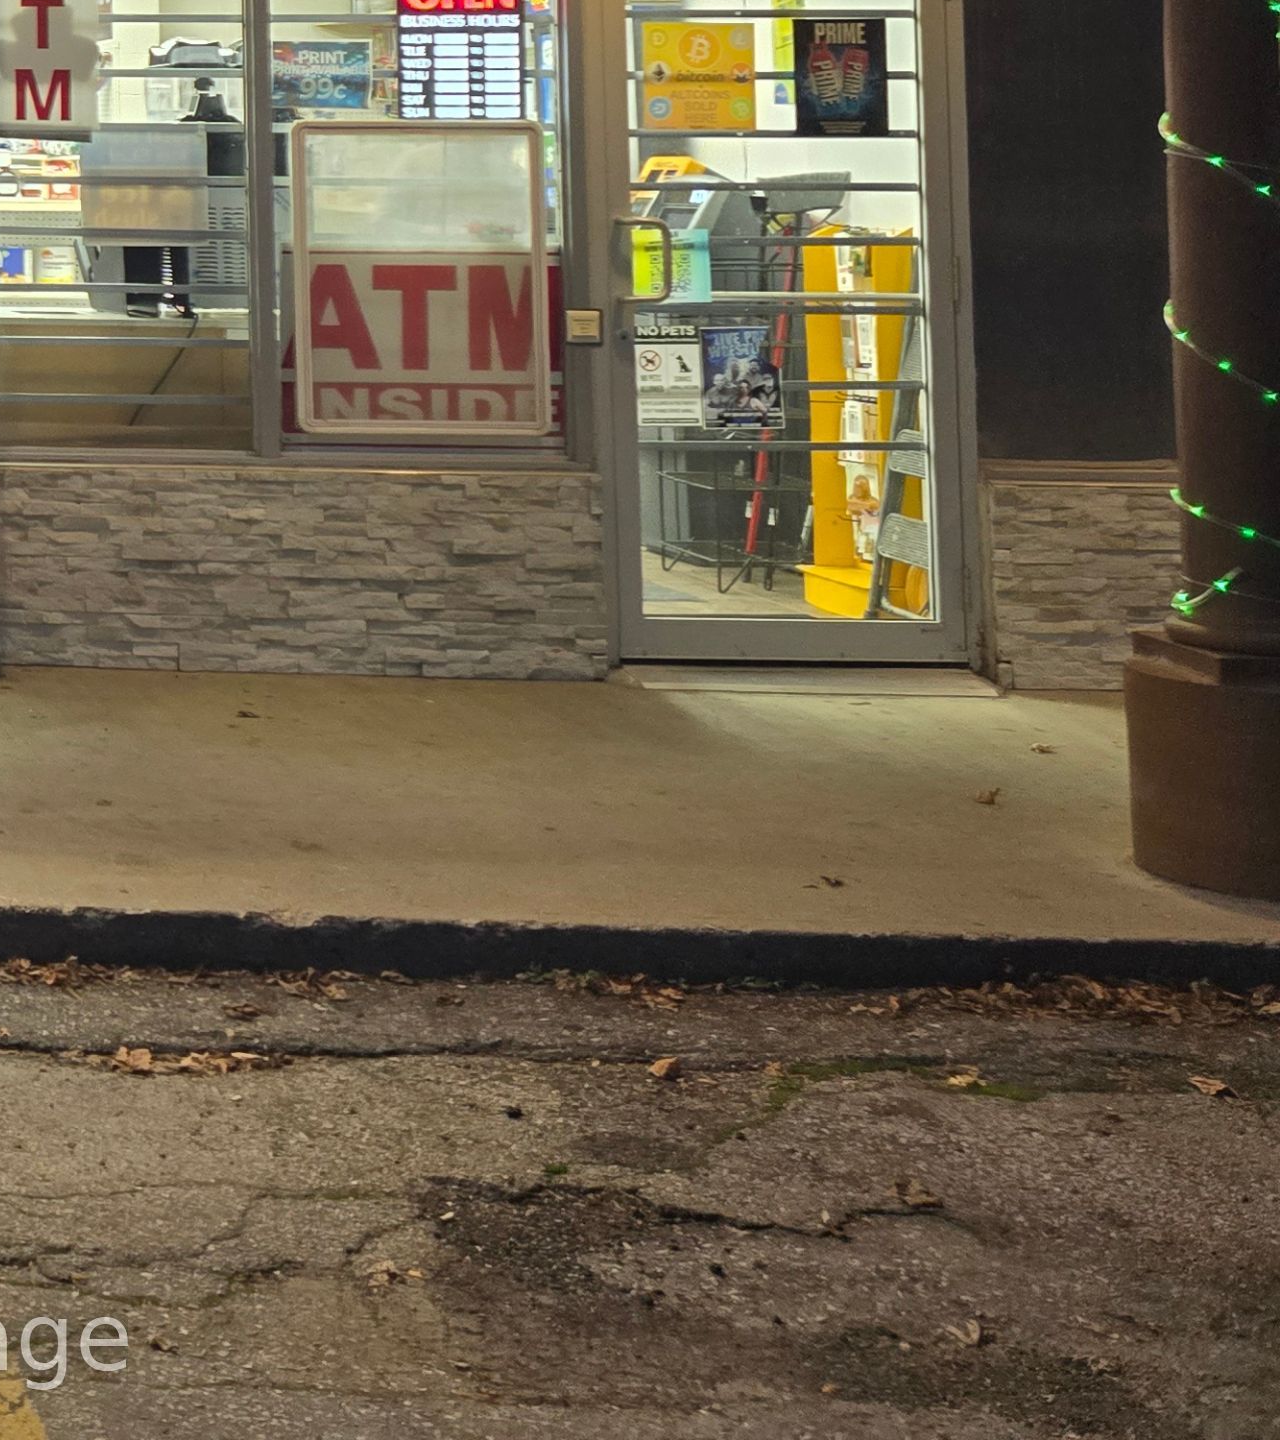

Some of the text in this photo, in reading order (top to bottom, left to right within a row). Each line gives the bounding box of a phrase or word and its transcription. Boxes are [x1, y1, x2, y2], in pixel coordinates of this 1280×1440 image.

[399, 14, 521, 27] BUSINESS HOURS
[814, 23, 867, 44] PRIME
[298, 50, 348, 64] PRINT
[676, 70, 725, 82] bitcoin
[671, 90, 731, 100] ALTCOINS
[684, 101, 717, 111] SOLD
[281, 263, 562, 371] ATM
[637, 326, 696, 336] NO PETS
[318, 387, 560, 432] NSIDE
